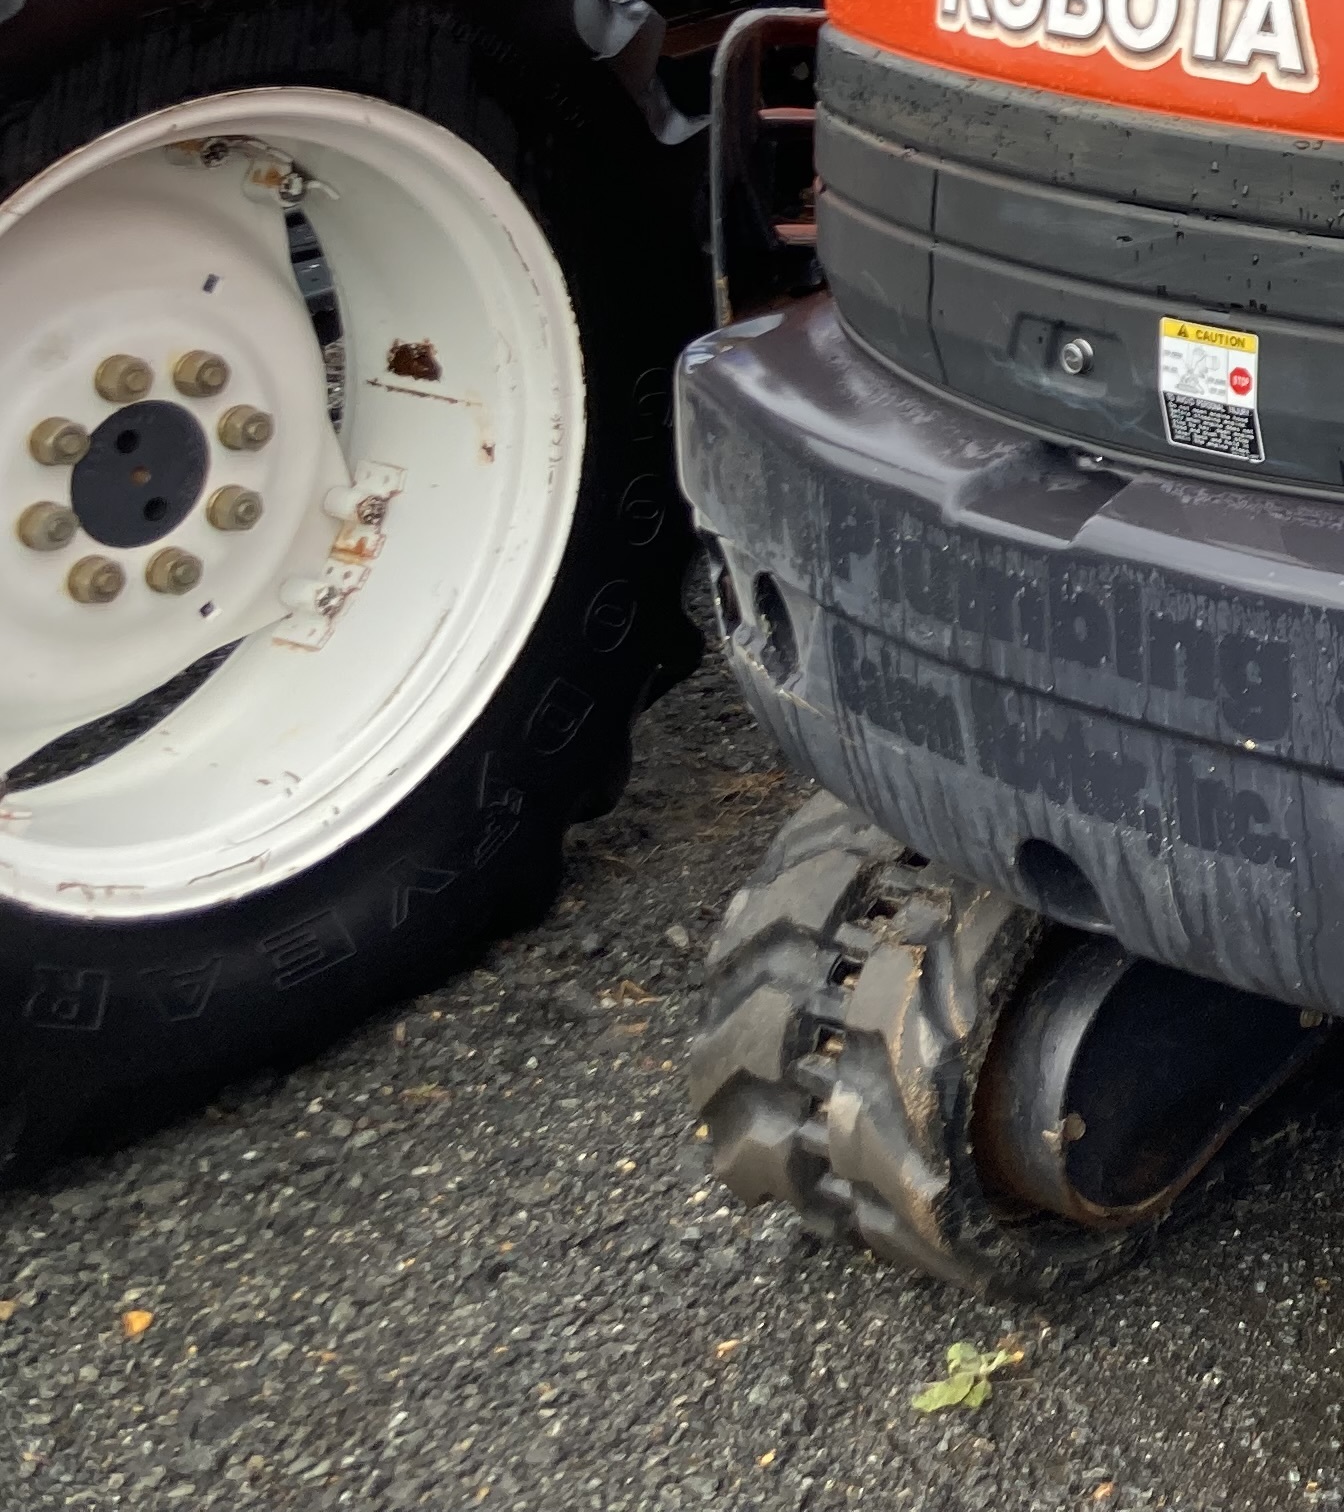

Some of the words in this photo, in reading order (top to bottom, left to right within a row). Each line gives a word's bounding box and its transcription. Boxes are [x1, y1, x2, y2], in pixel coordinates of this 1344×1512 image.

[1195, 329, 1246, 348] CAUTION
[1232, 373, 1250, 387] STOP
[830, 486, 1292, 740] Plumbing
[1173, 744, 1297, 870] Inc.
